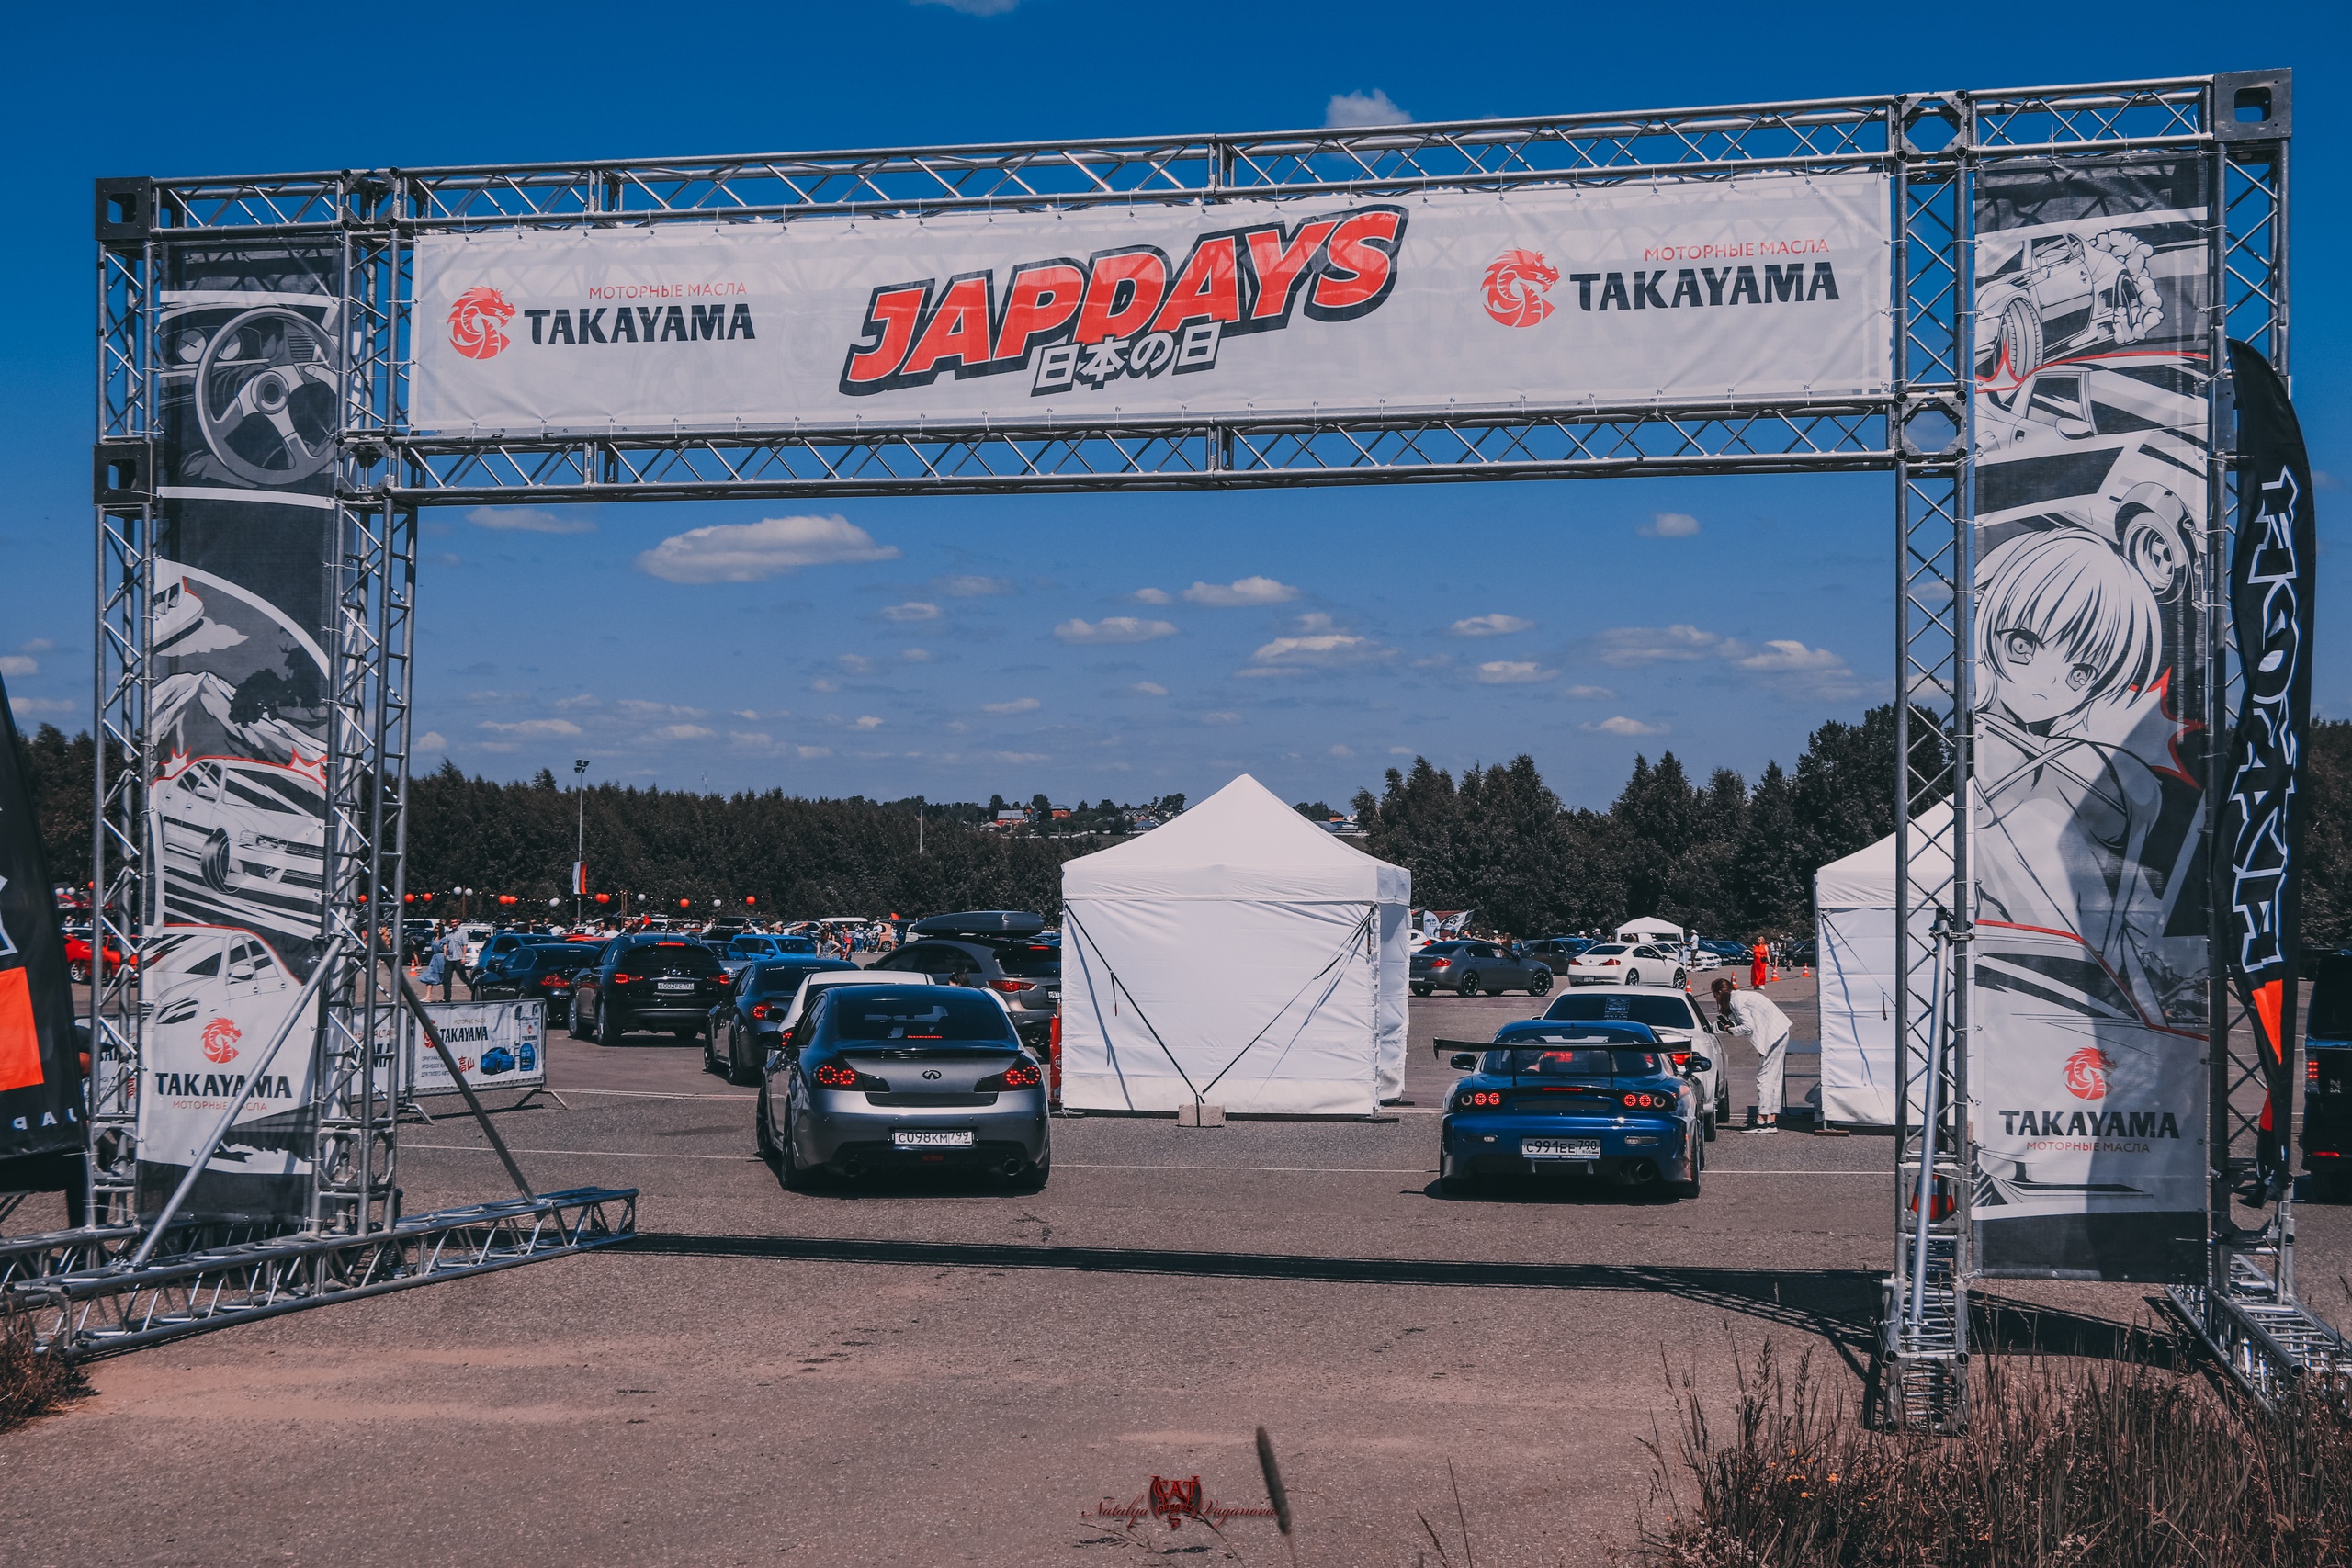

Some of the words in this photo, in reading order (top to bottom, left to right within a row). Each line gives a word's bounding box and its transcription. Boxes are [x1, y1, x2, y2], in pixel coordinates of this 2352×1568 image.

[1644, 242, 1754, 262] МОТОРНЫЕ
[1759, 238, 1829, 255] МАСЛА
[589, 284, 683, 299] МОТОРНЫЕ
[688, 282, 747, 296] МАСЛА
[1569, 261, 1840, 311] TAKAYAMA
[840, 204, 1409, 396] JAPDAYS
[524, 303, 756, 345] TAKAYAMA
[1031, 322, 1222, 397] 日本の日
[440, 1026, 489, 1043] TAKAYAMA
[173, 1100, 228, 1111] МОТОРНЫЕ
[1999, 1110, 2180, 1139] TAKAYAMA
[950, 1131, 968, 1141] 799
[1578, 1140, 1597, 1150] 790
[2027, 1141, 2100, 1151] МОТОРНЫЕ
[2103, 1142, 2150, 1153] МАСЛА
